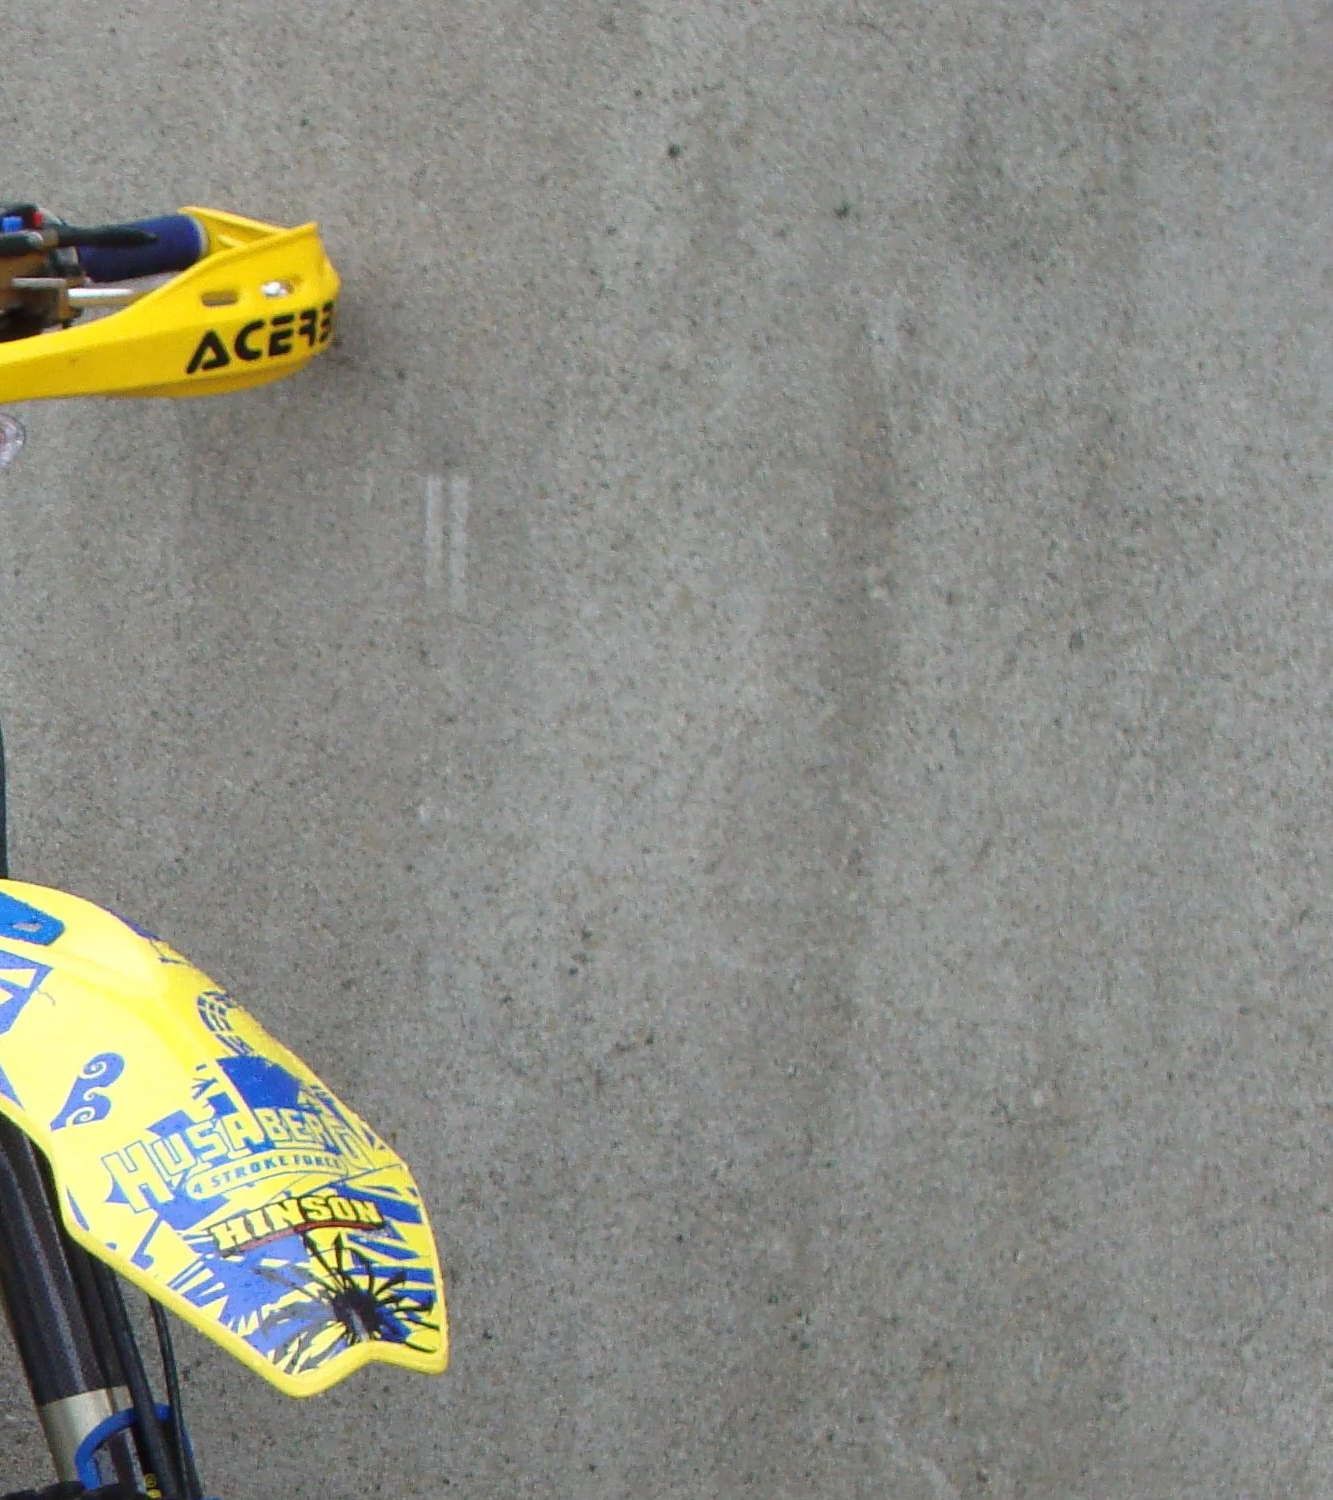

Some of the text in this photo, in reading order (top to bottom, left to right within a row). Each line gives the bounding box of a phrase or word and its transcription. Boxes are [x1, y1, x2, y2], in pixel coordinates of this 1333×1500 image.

[102, 1107, 374, 1213] HUSABERG
[211, 1154, 289, 1188] STROKE
[208, 1195, 384, 1252] HINSON
